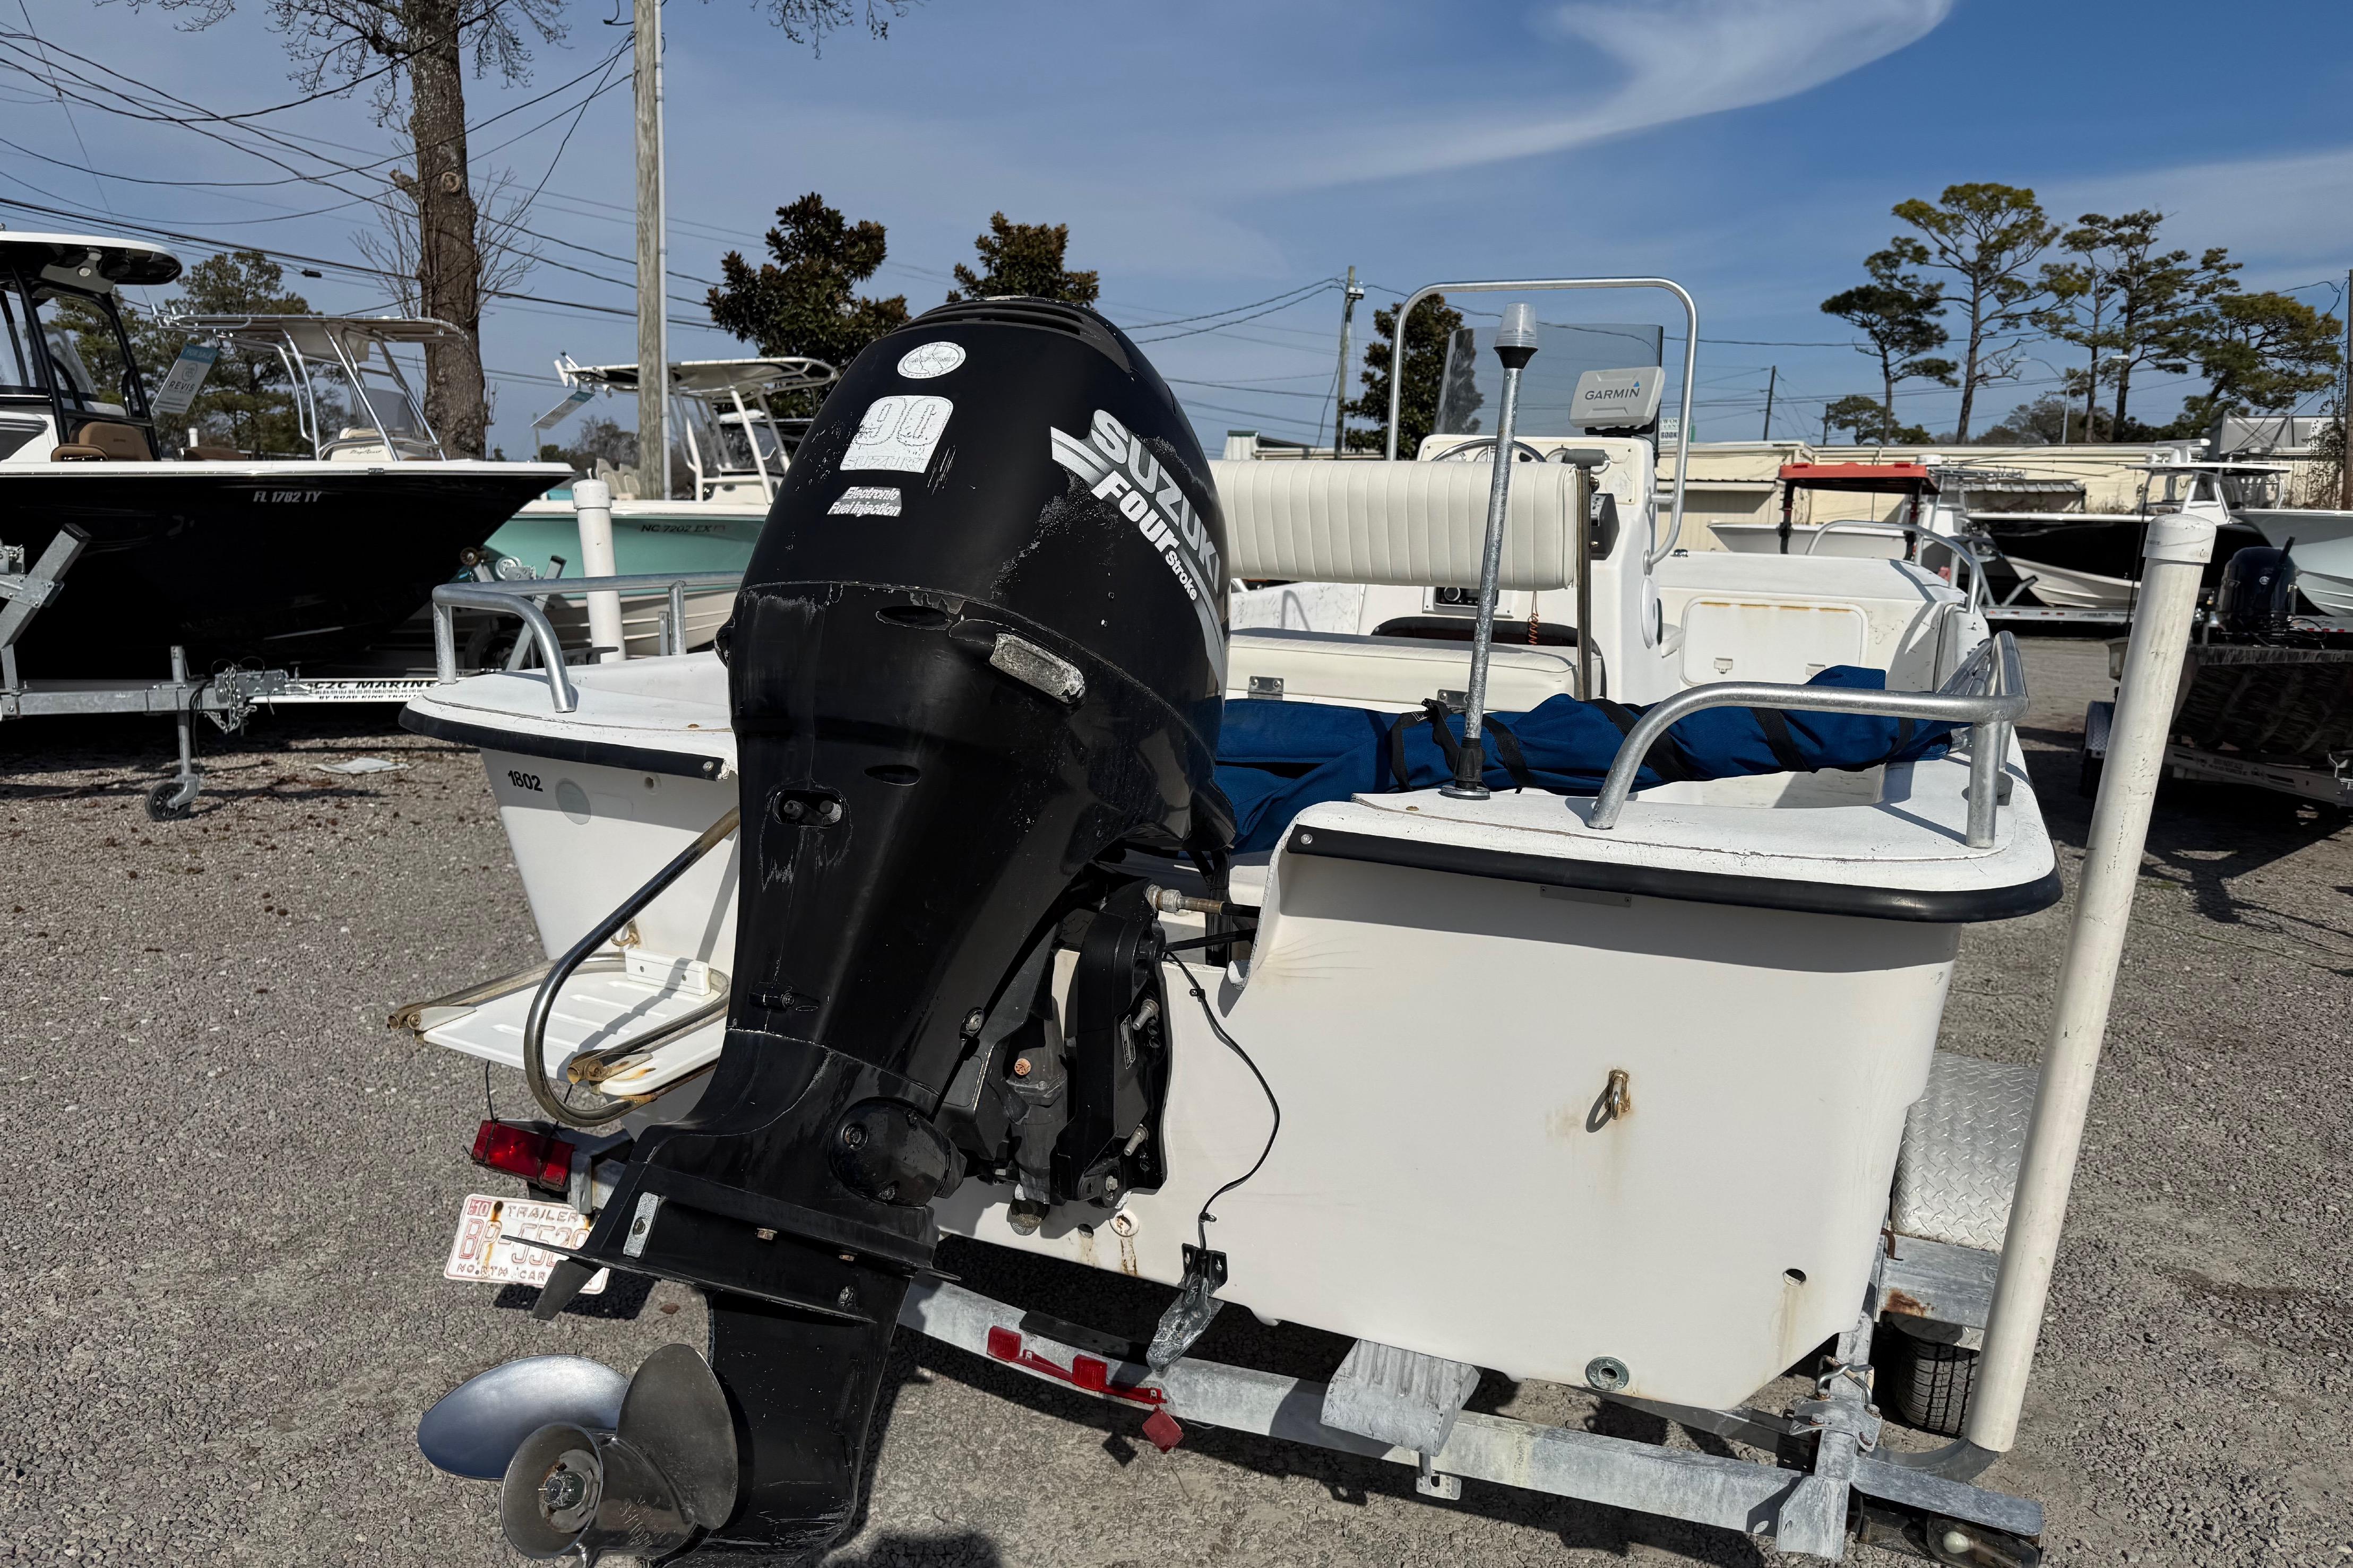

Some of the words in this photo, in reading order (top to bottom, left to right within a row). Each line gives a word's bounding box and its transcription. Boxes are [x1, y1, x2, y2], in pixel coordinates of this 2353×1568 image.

[169, 381, 195, 392] REVIS
[1585, 388, 1640, 400] GARMIN
[855, 397, 952, 447] 90
[842, 456, 926, 471] SUZUKI
[253, 491, 267, 502] FL
[305, 491, 323, 502] TY
[843, 487, 900, 500] Electronic
[827, 501, 855, 515] Fuel
[1091, 409, 1220, 594] SUZUKI
[1165, 550, 1197, 601] Stroke
[356, 680, 436, 689] MARINE
[508, 770, 544, 792] 1802
[475, 1201, 489, 1216] 10
[508, 1205, 578, 1222] TRAILER
